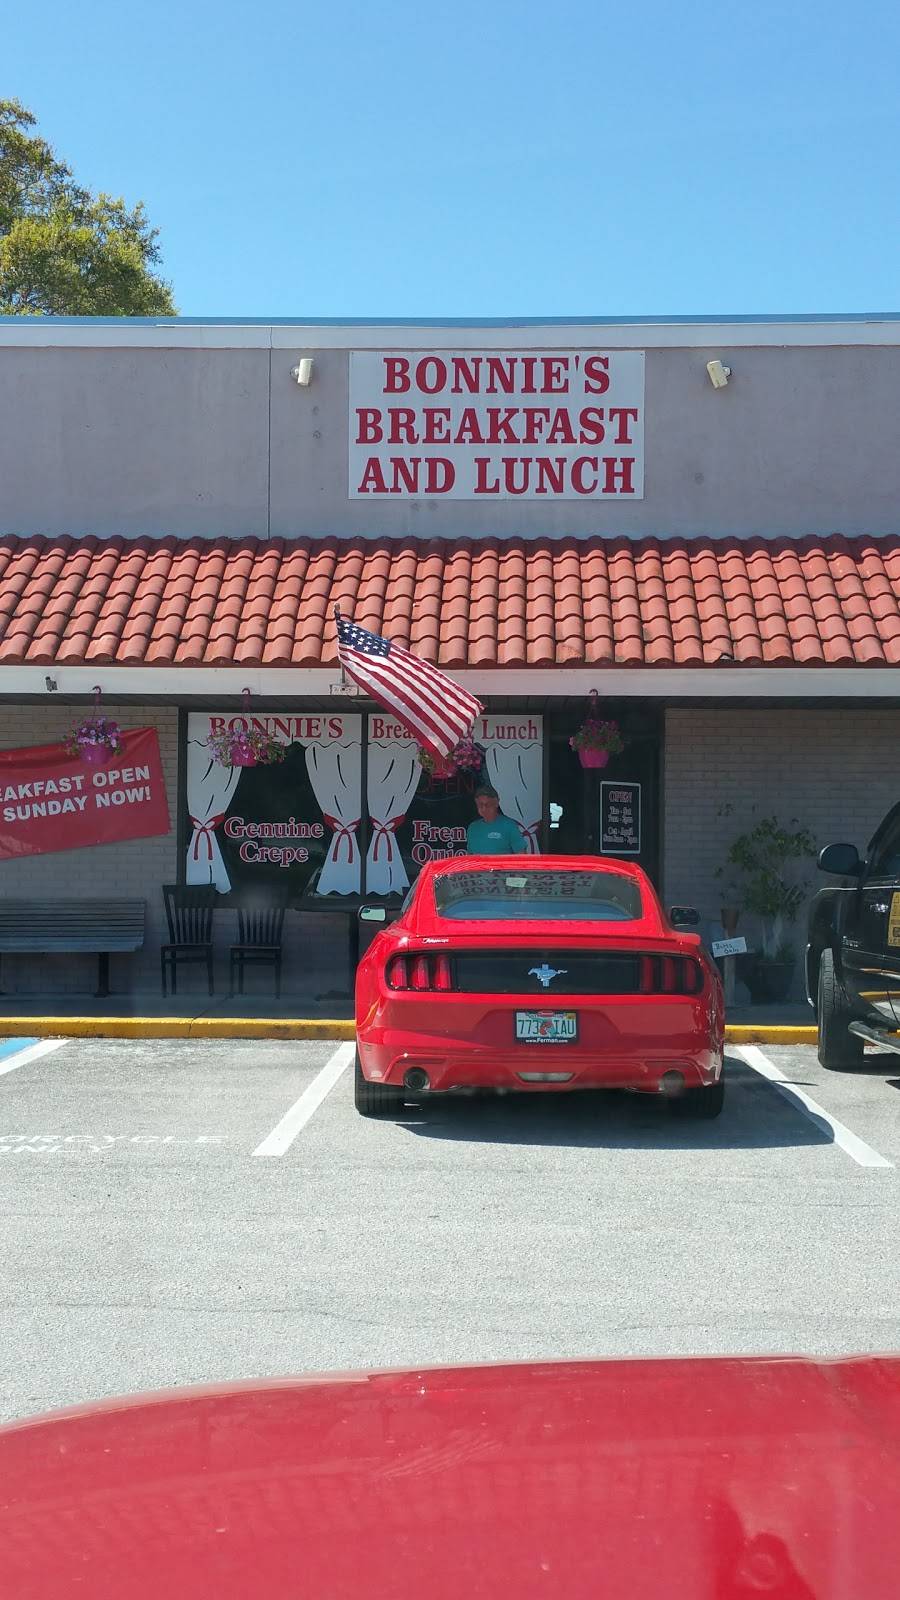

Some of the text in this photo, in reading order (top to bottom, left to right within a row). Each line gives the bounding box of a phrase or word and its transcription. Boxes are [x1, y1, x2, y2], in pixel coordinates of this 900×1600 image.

[382, 355, 610, 395] BONNIE'S
[355, 407, 639, 445] BREAKFAST
[357, 456, 636, 495] AND LUNCH
[209, 717, 344, 739] BONNIE'S
[481, 719, 538, 740] Lunch
[0, 765, 150, 802] AKFAST OPEN
[3, 785, 151, 822] SUNDAY NOW!
[224, 816, 325, 839] Genuine
[239, 840, 309, 868] Crepe
[517, 1019, 575, 1035] 773 IAU
